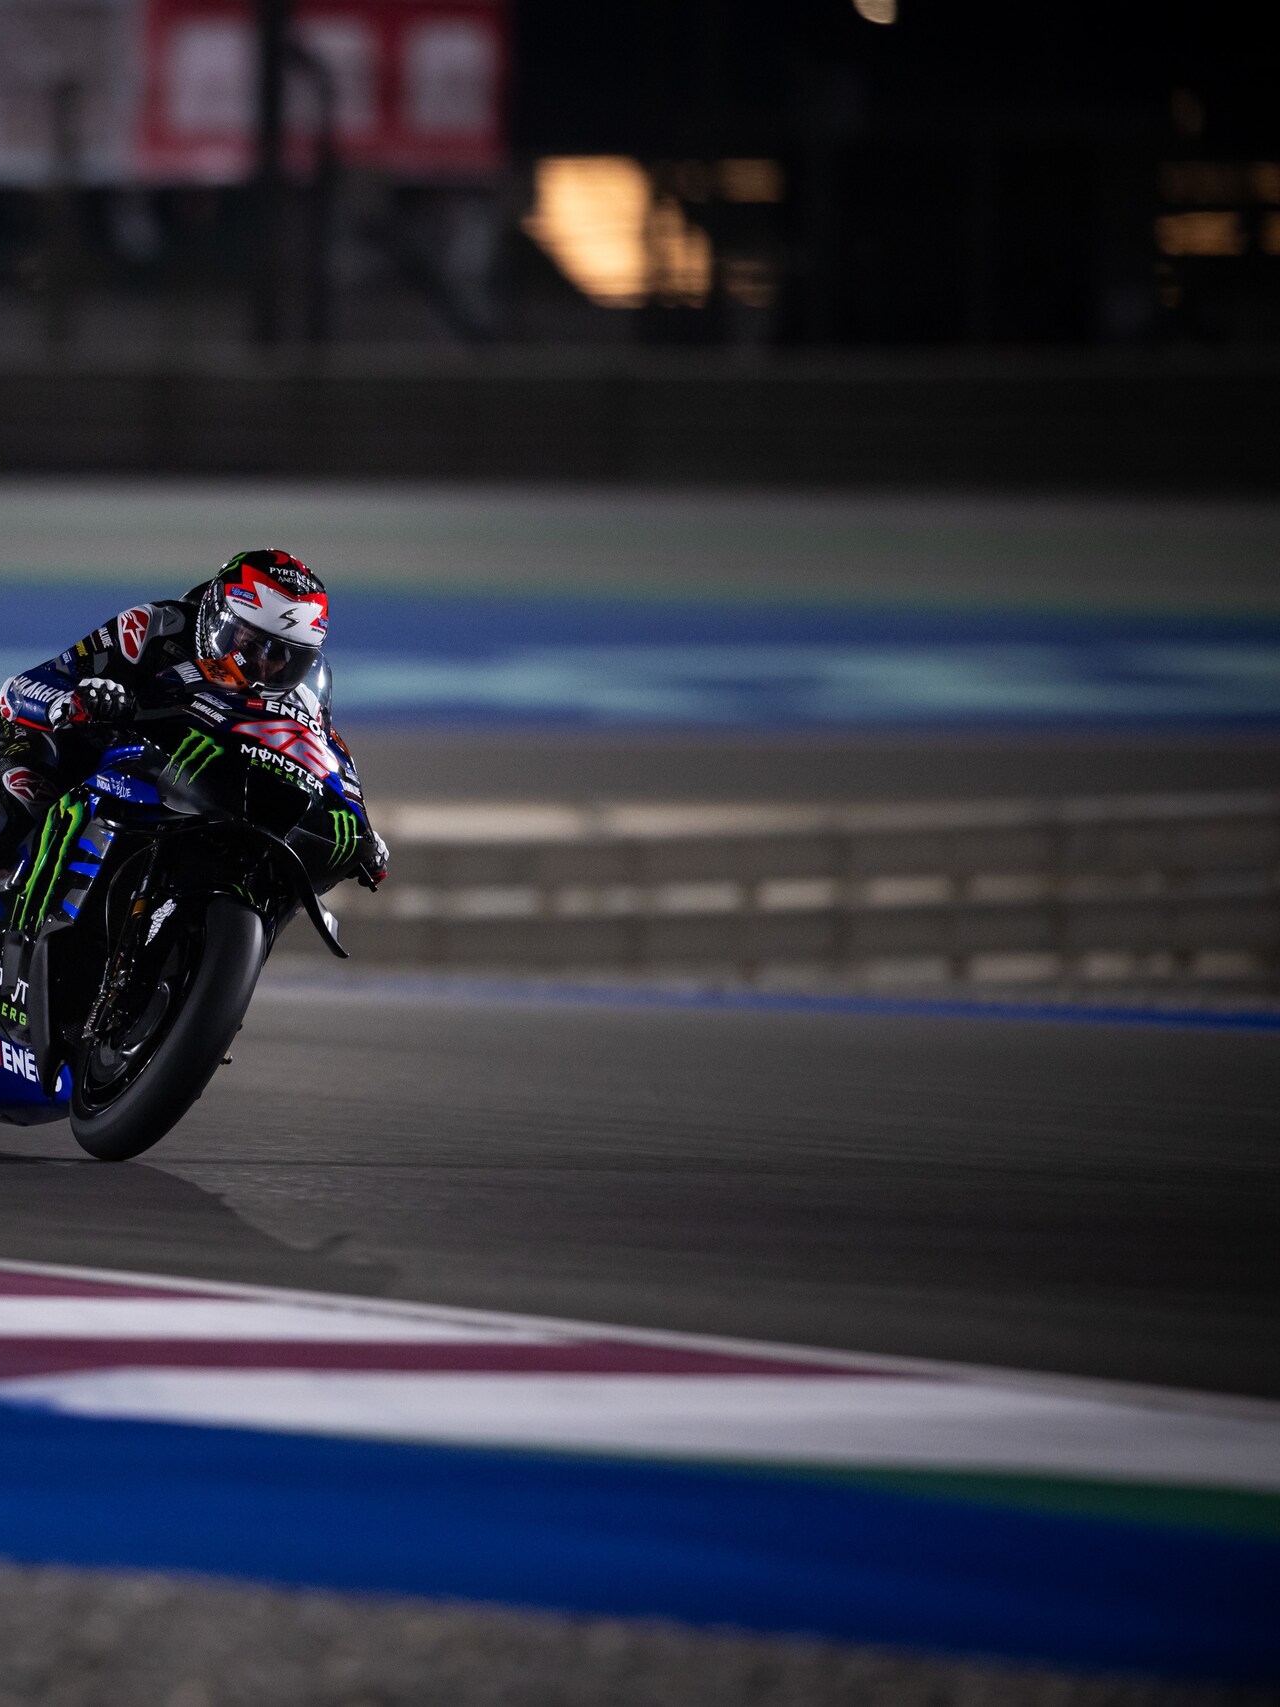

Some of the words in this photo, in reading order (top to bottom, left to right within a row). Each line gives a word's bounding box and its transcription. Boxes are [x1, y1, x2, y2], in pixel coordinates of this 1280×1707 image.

[190, 700, 228, 724] YAMALUBE
[265, 700, 328, 746] ENEOS
[232, 720, 340, 780] 42
[1, 1040, 41, 1084] ENE
